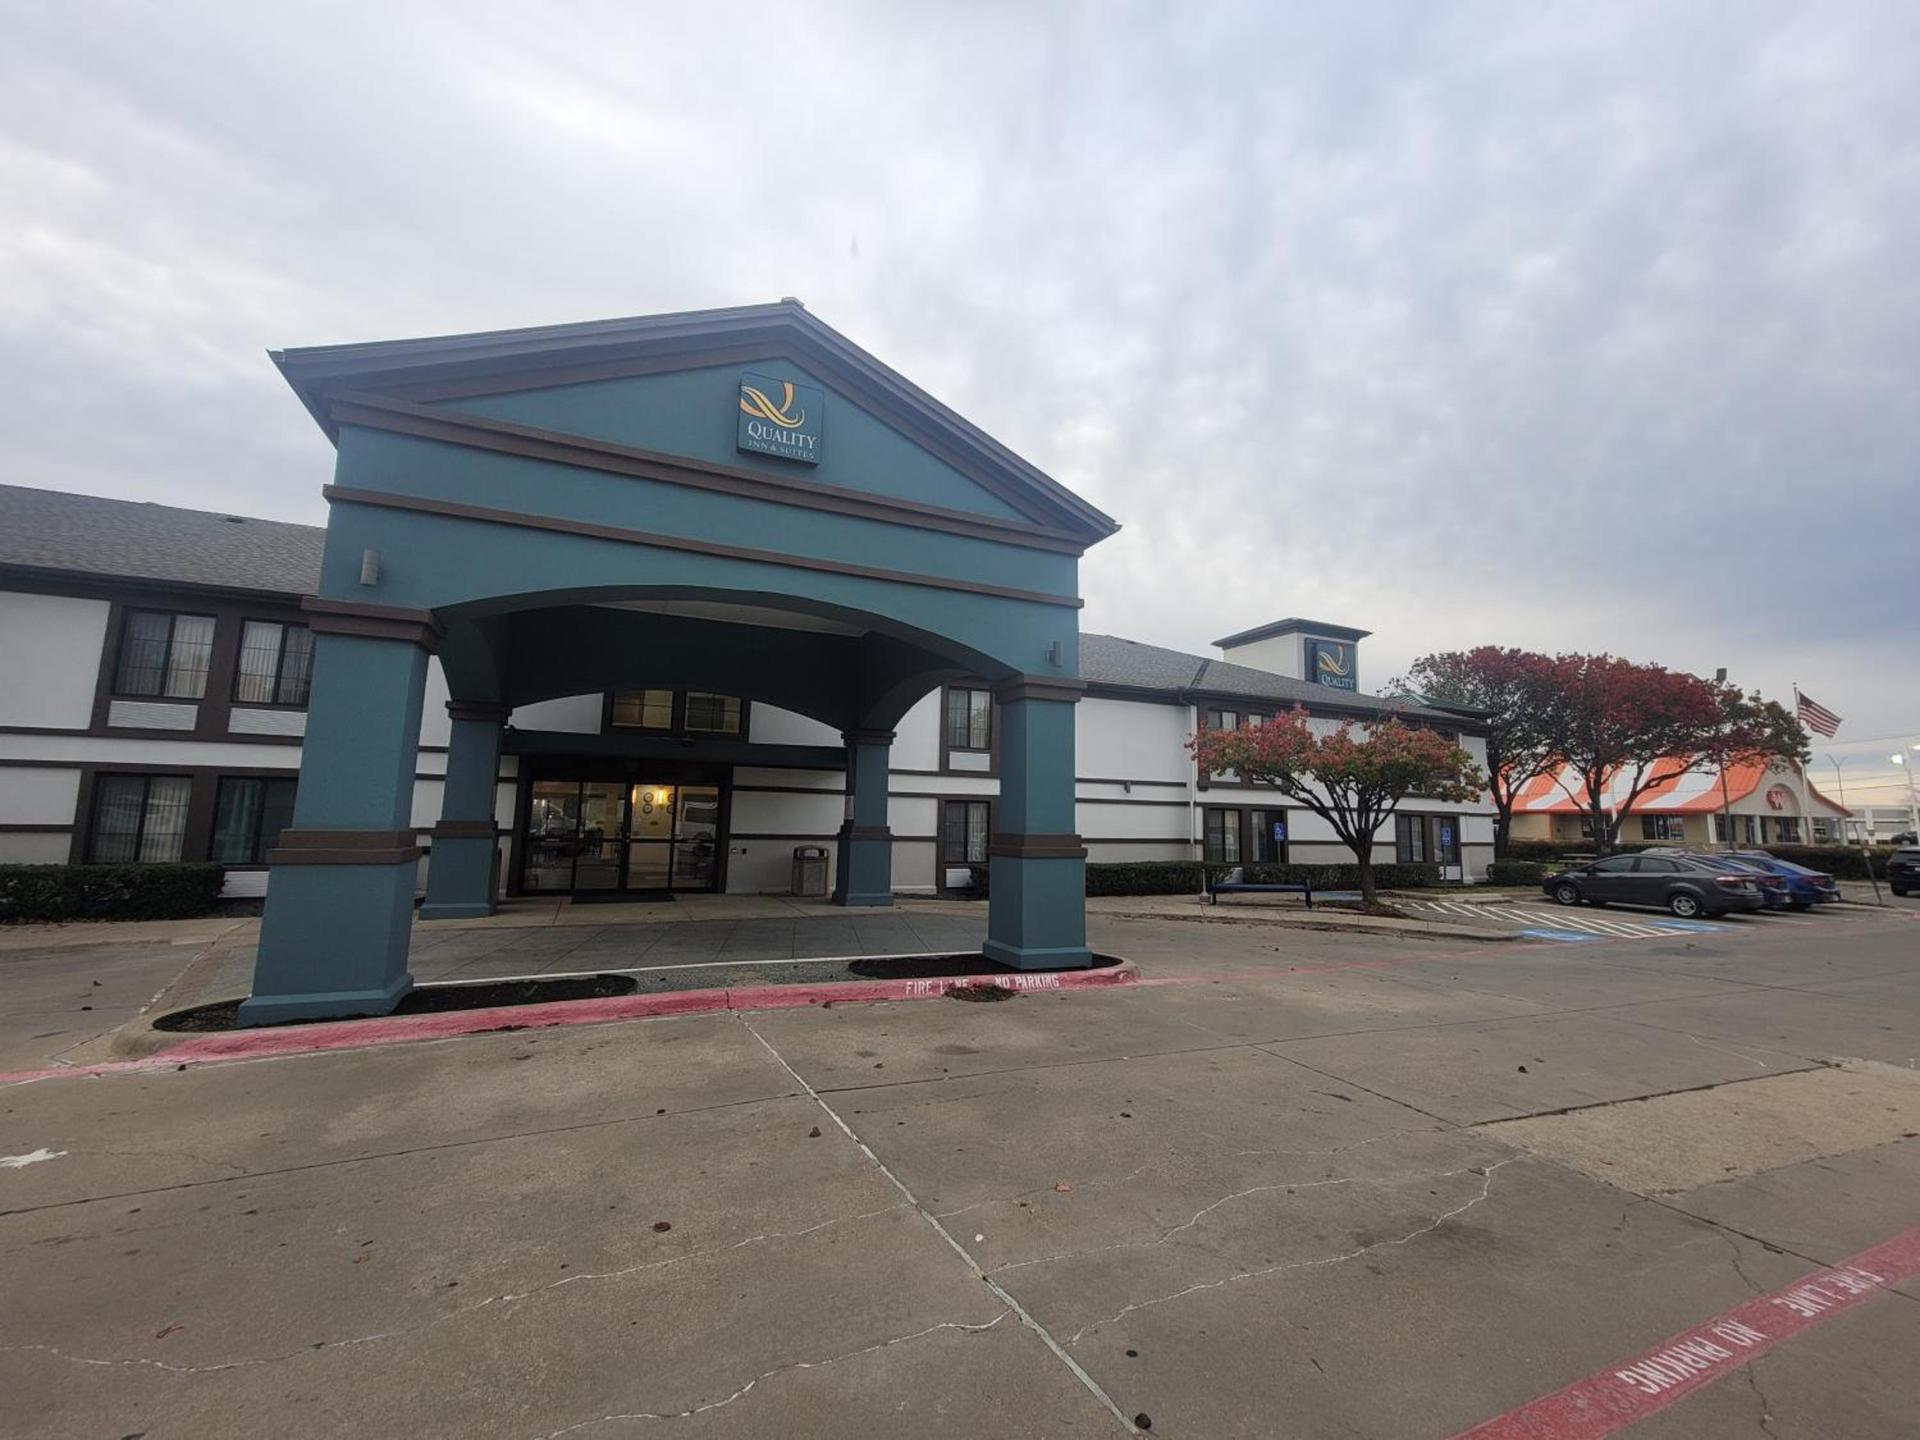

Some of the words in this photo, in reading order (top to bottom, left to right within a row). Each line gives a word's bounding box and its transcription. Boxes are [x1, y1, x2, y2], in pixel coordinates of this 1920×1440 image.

[748, 420, 817, 449] QUALITY
[748, 440, 768, 449] INN
[780, 447, 815, 458] SUITES
[1321, 674, 1354, 688] QUALITY
[905, 981, 933, 995] FIRE
[994, 976, 1010, 989] NO
[1014, 975, 1060, 990] PARKING
[1771, 1284, 1845, 1317] LANE
[1712, 1319, 1768, 1346] NO
[1615, 1336, 1734, 1394] PARKING
